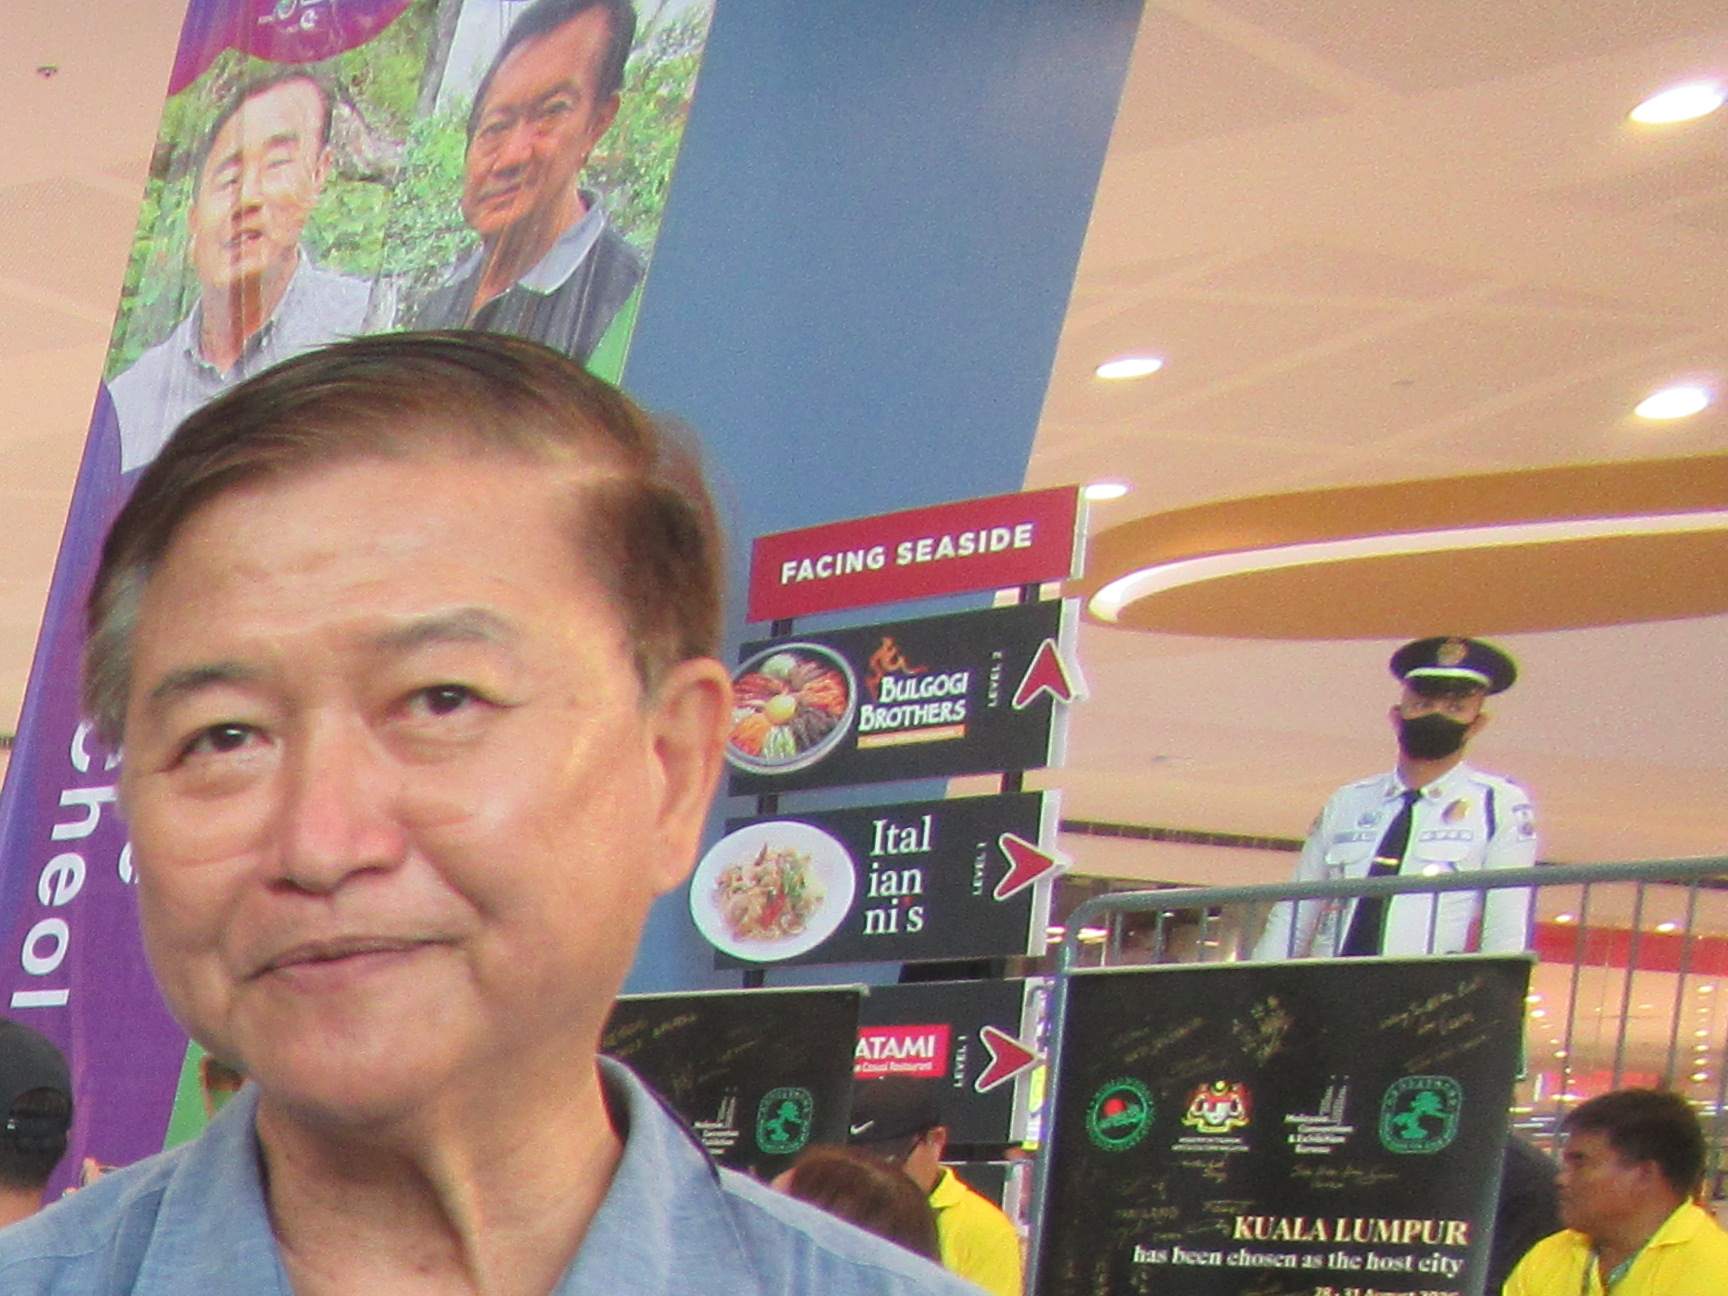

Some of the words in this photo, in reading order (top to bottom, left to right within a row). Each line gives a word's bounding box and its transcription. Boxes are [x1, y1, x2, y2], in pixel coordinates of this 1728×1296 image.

[780, 545, 886, 585] FACING
[895, 522, 1035, 566] SEASIDE
[879, 672, 970, 703] BULGOGI
[857, 700, 967, 732] BROTHERS
[869, 814, 932, 857] Ital
[866, 862, 923, 898] ian
[854, 1035, 936, 1060] ATAMI
[1232, 1215, 1327, 1242] KUALA
[1333, 1217, 1470, 1246] LUMPUR
[1133, 1244, 1168, 1265] has
[1171, 1245, 1223, 1267] been
[1226, 1247, 1296, 1269] chosen
[1301, 1252, 1322, 1269] as
[1327, 1250, 1363, 1271] the
[1366, 1251, 1413, 1272] host
[1417, 1253, 1466, 1278] city
